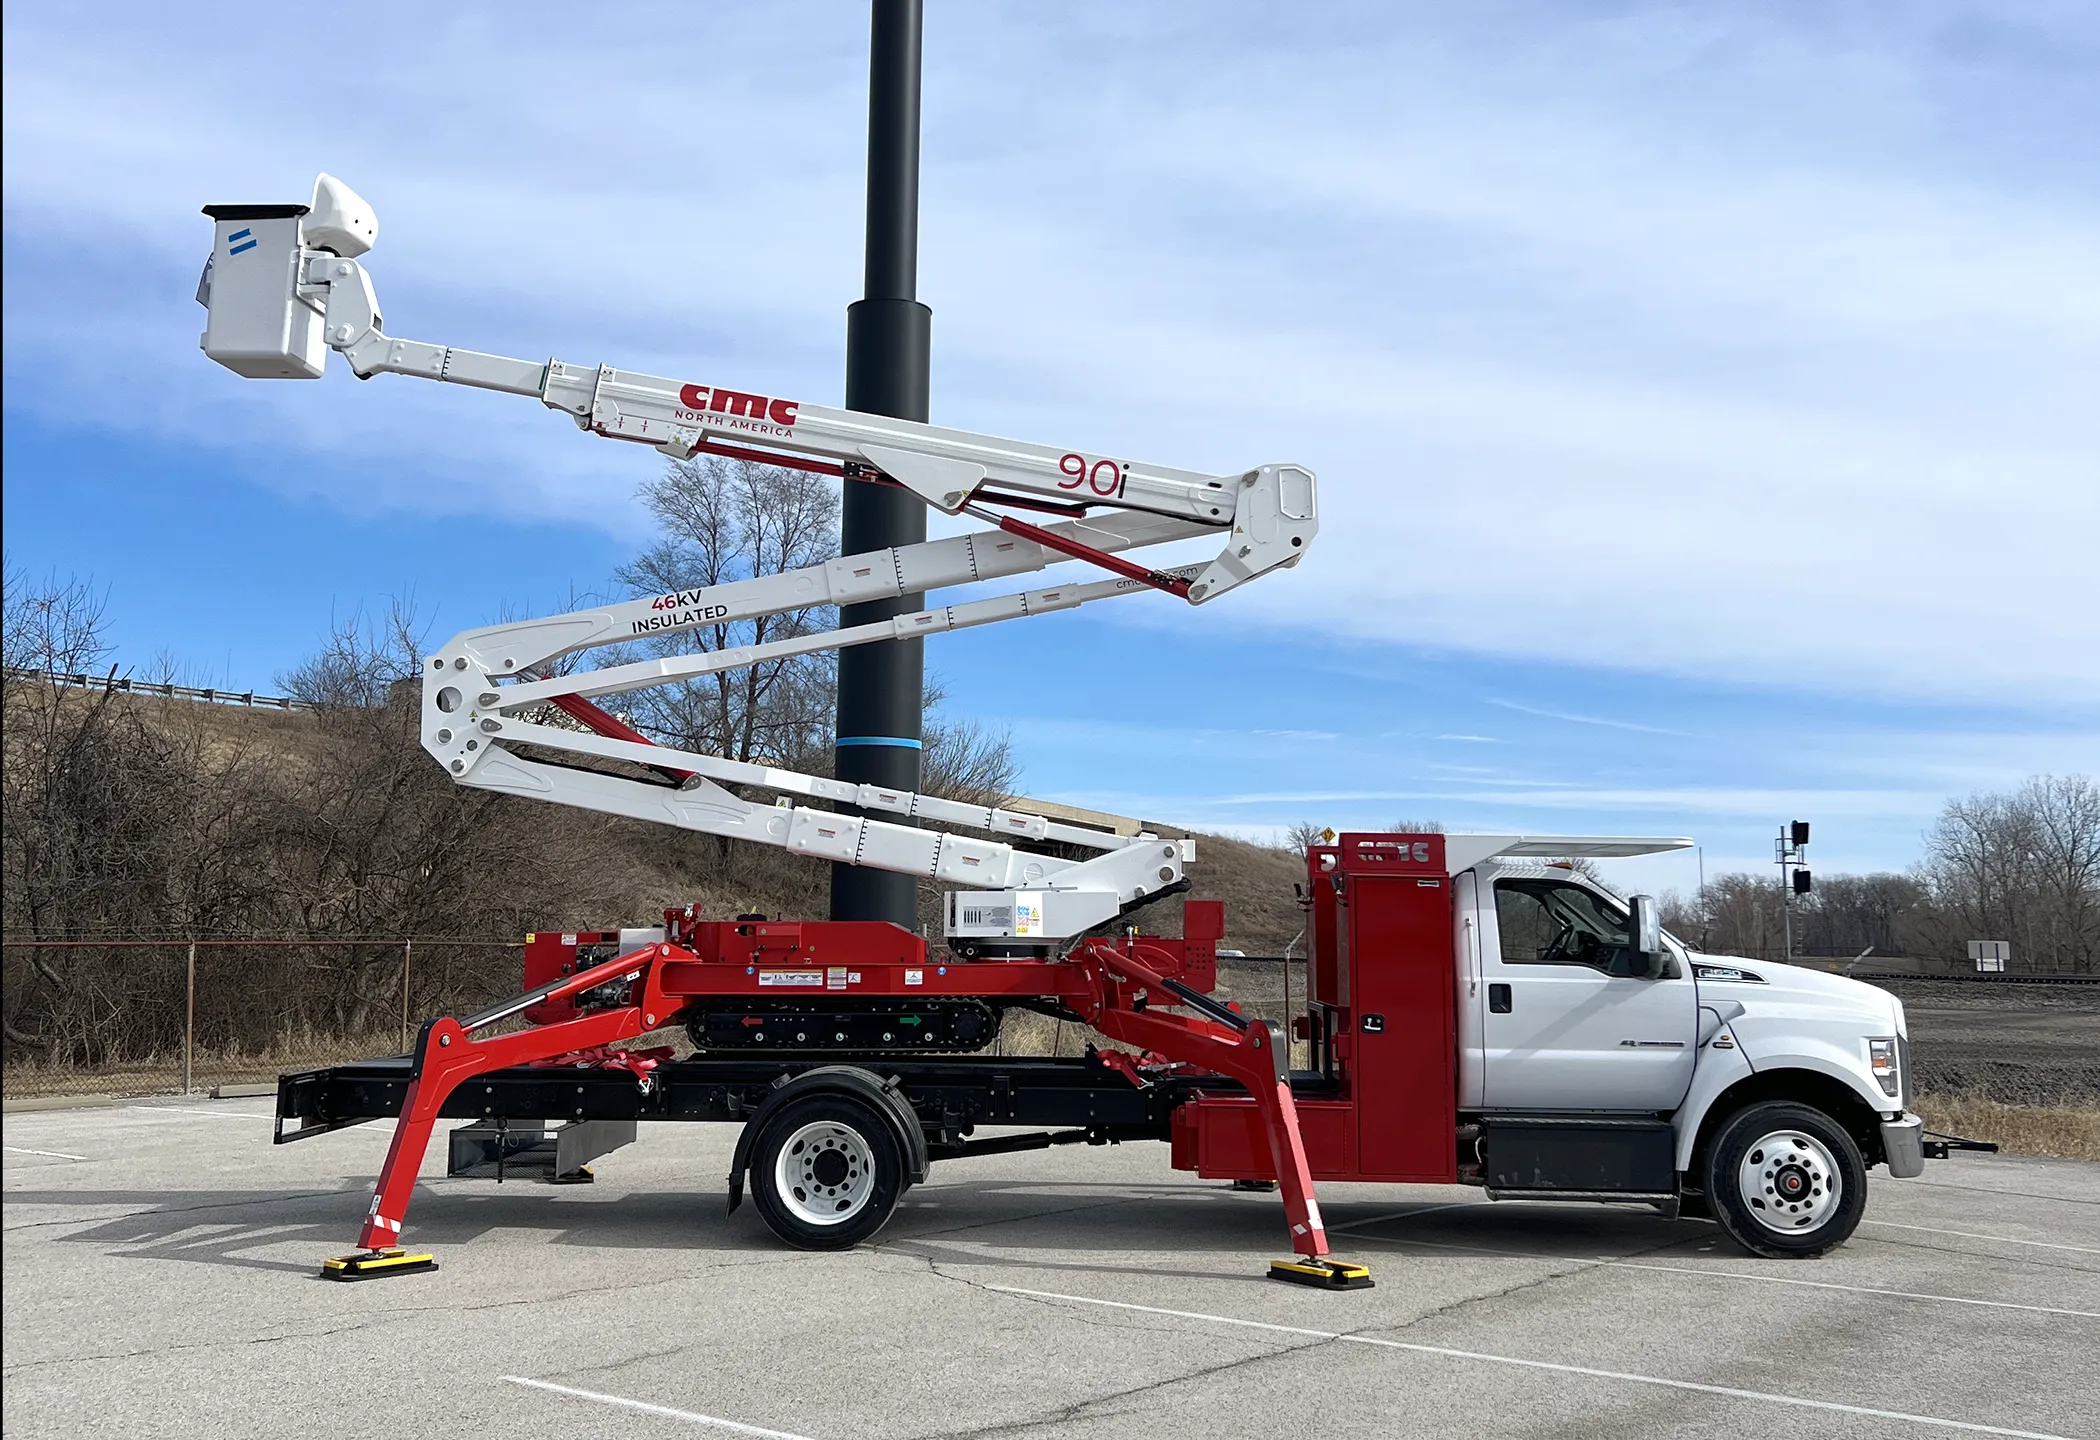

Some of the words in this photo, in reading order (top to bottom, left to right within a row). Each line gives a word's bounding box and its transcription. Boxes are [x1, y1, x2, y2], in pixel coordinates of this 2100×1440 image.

[680, 384, 799, 426] cmc
[675, 410, 723, 426] NORTH
[730, 419, 793, 438] AMERICA
[1057, 454, 1130, 499] 90i
[652, 589, 702, 611] 46kV
[631, 605, 728, 634] INSULATED
